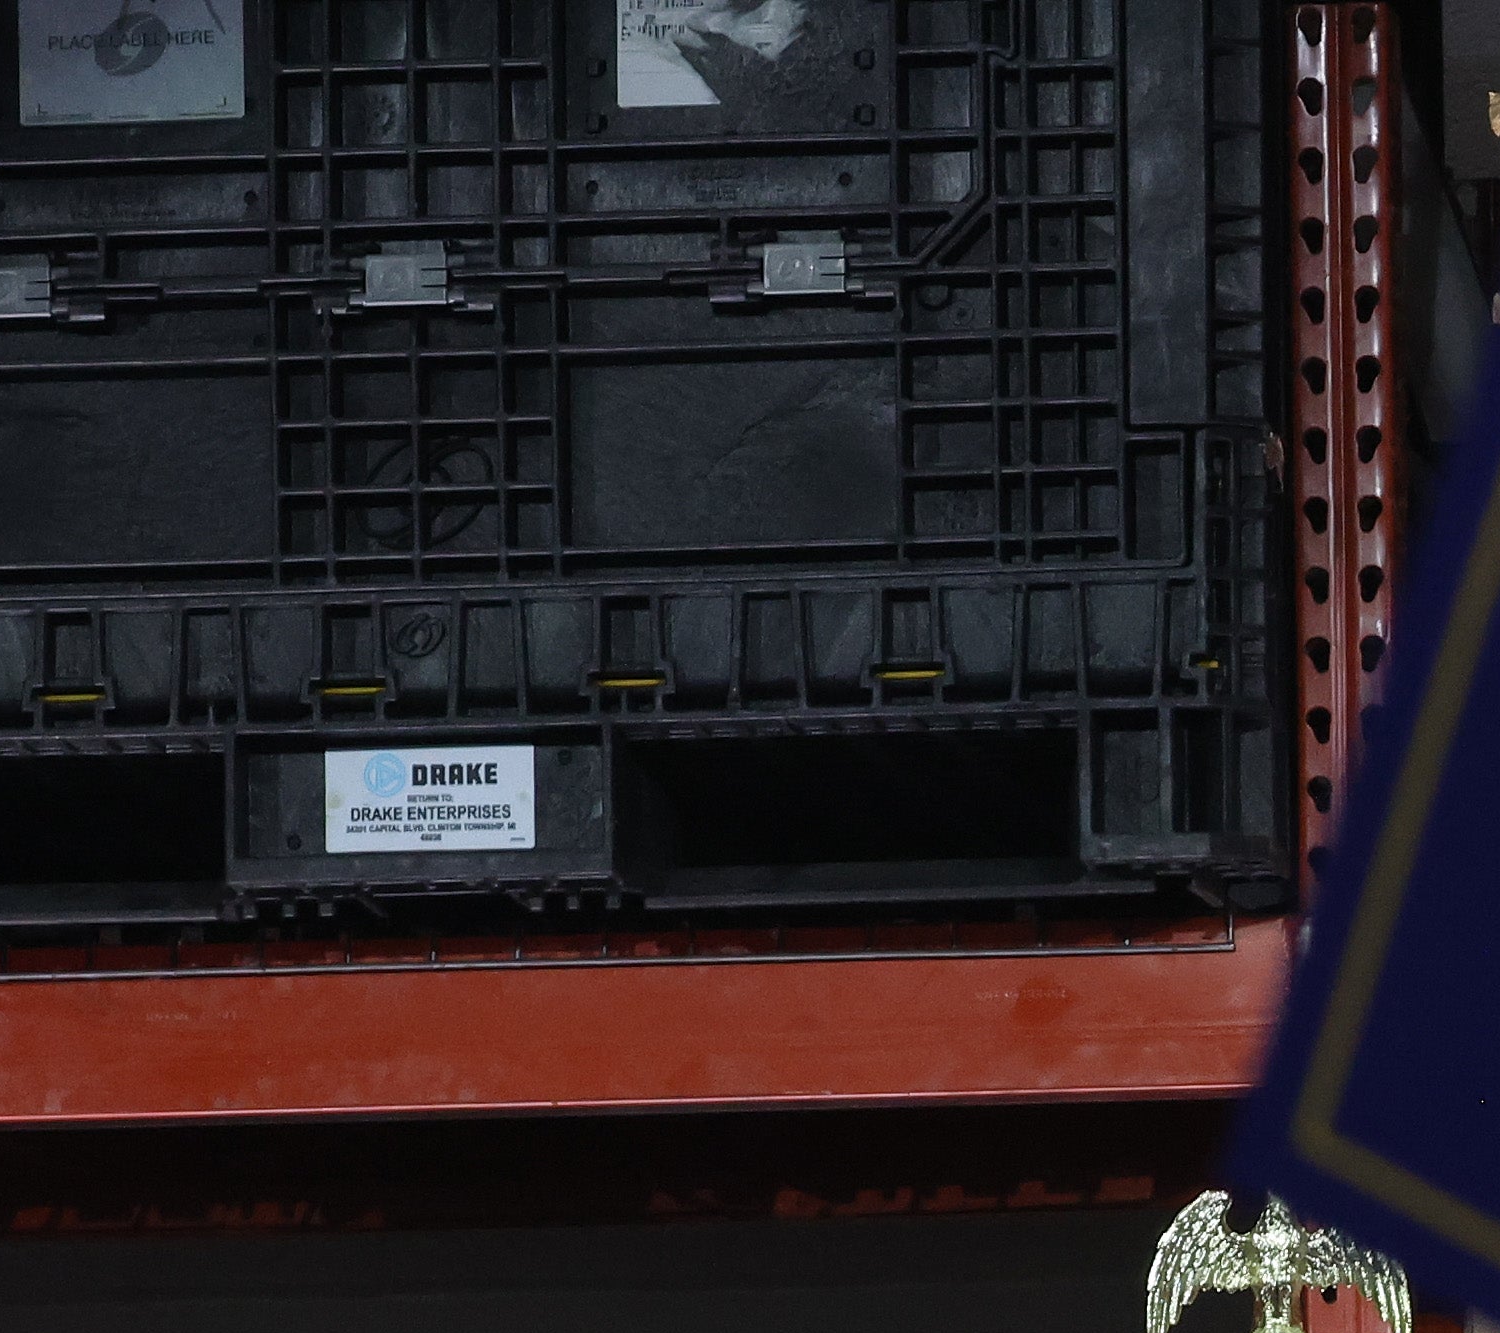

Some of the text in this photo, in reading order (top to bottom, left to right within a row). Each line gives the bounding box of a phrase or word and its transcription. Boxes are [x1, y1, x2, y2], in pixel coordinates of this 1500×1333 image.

[47, 34, 108, 50] PLACE
[167, 29, 215, 46] HERE
[411, 762, 498, 787] DRAKE
[350, 803, 512, 822] DRAKE ENTERPRISES
[368, 824, 401, 833] CAPITAL
